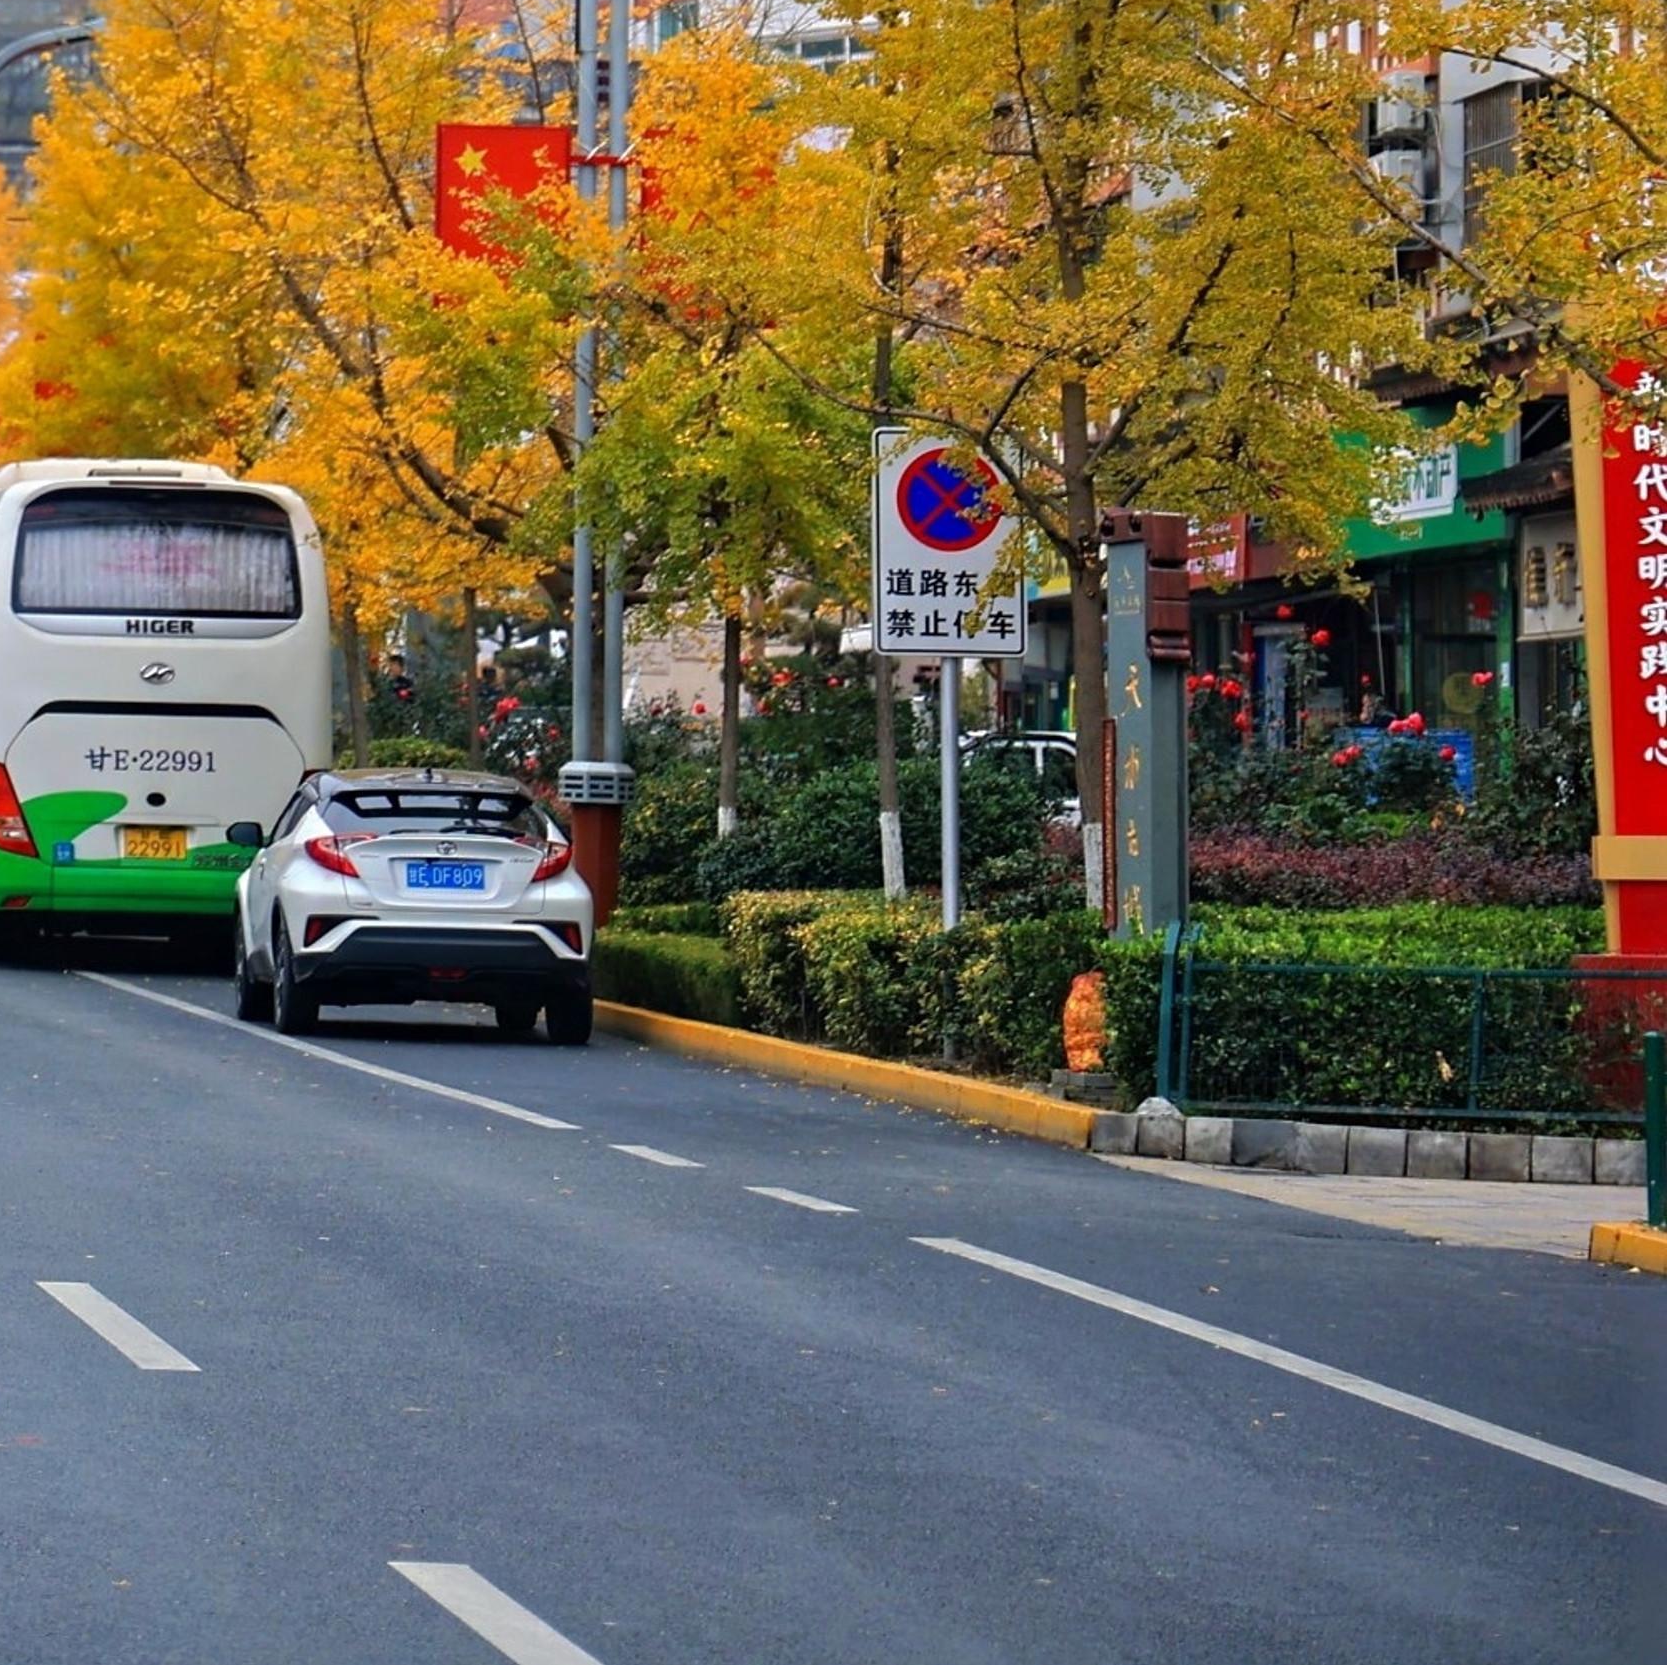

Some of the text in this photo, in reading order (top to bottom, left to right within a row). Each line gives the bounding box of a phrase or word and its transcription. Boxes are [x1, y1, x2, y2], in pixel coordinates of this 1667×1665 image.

[886, 568, 1017, 598] 道路东
[126, 619, 194, 635] HIGER
[127, 840, 182, 857] 22991
[433, 867, 483, 887] DF809
